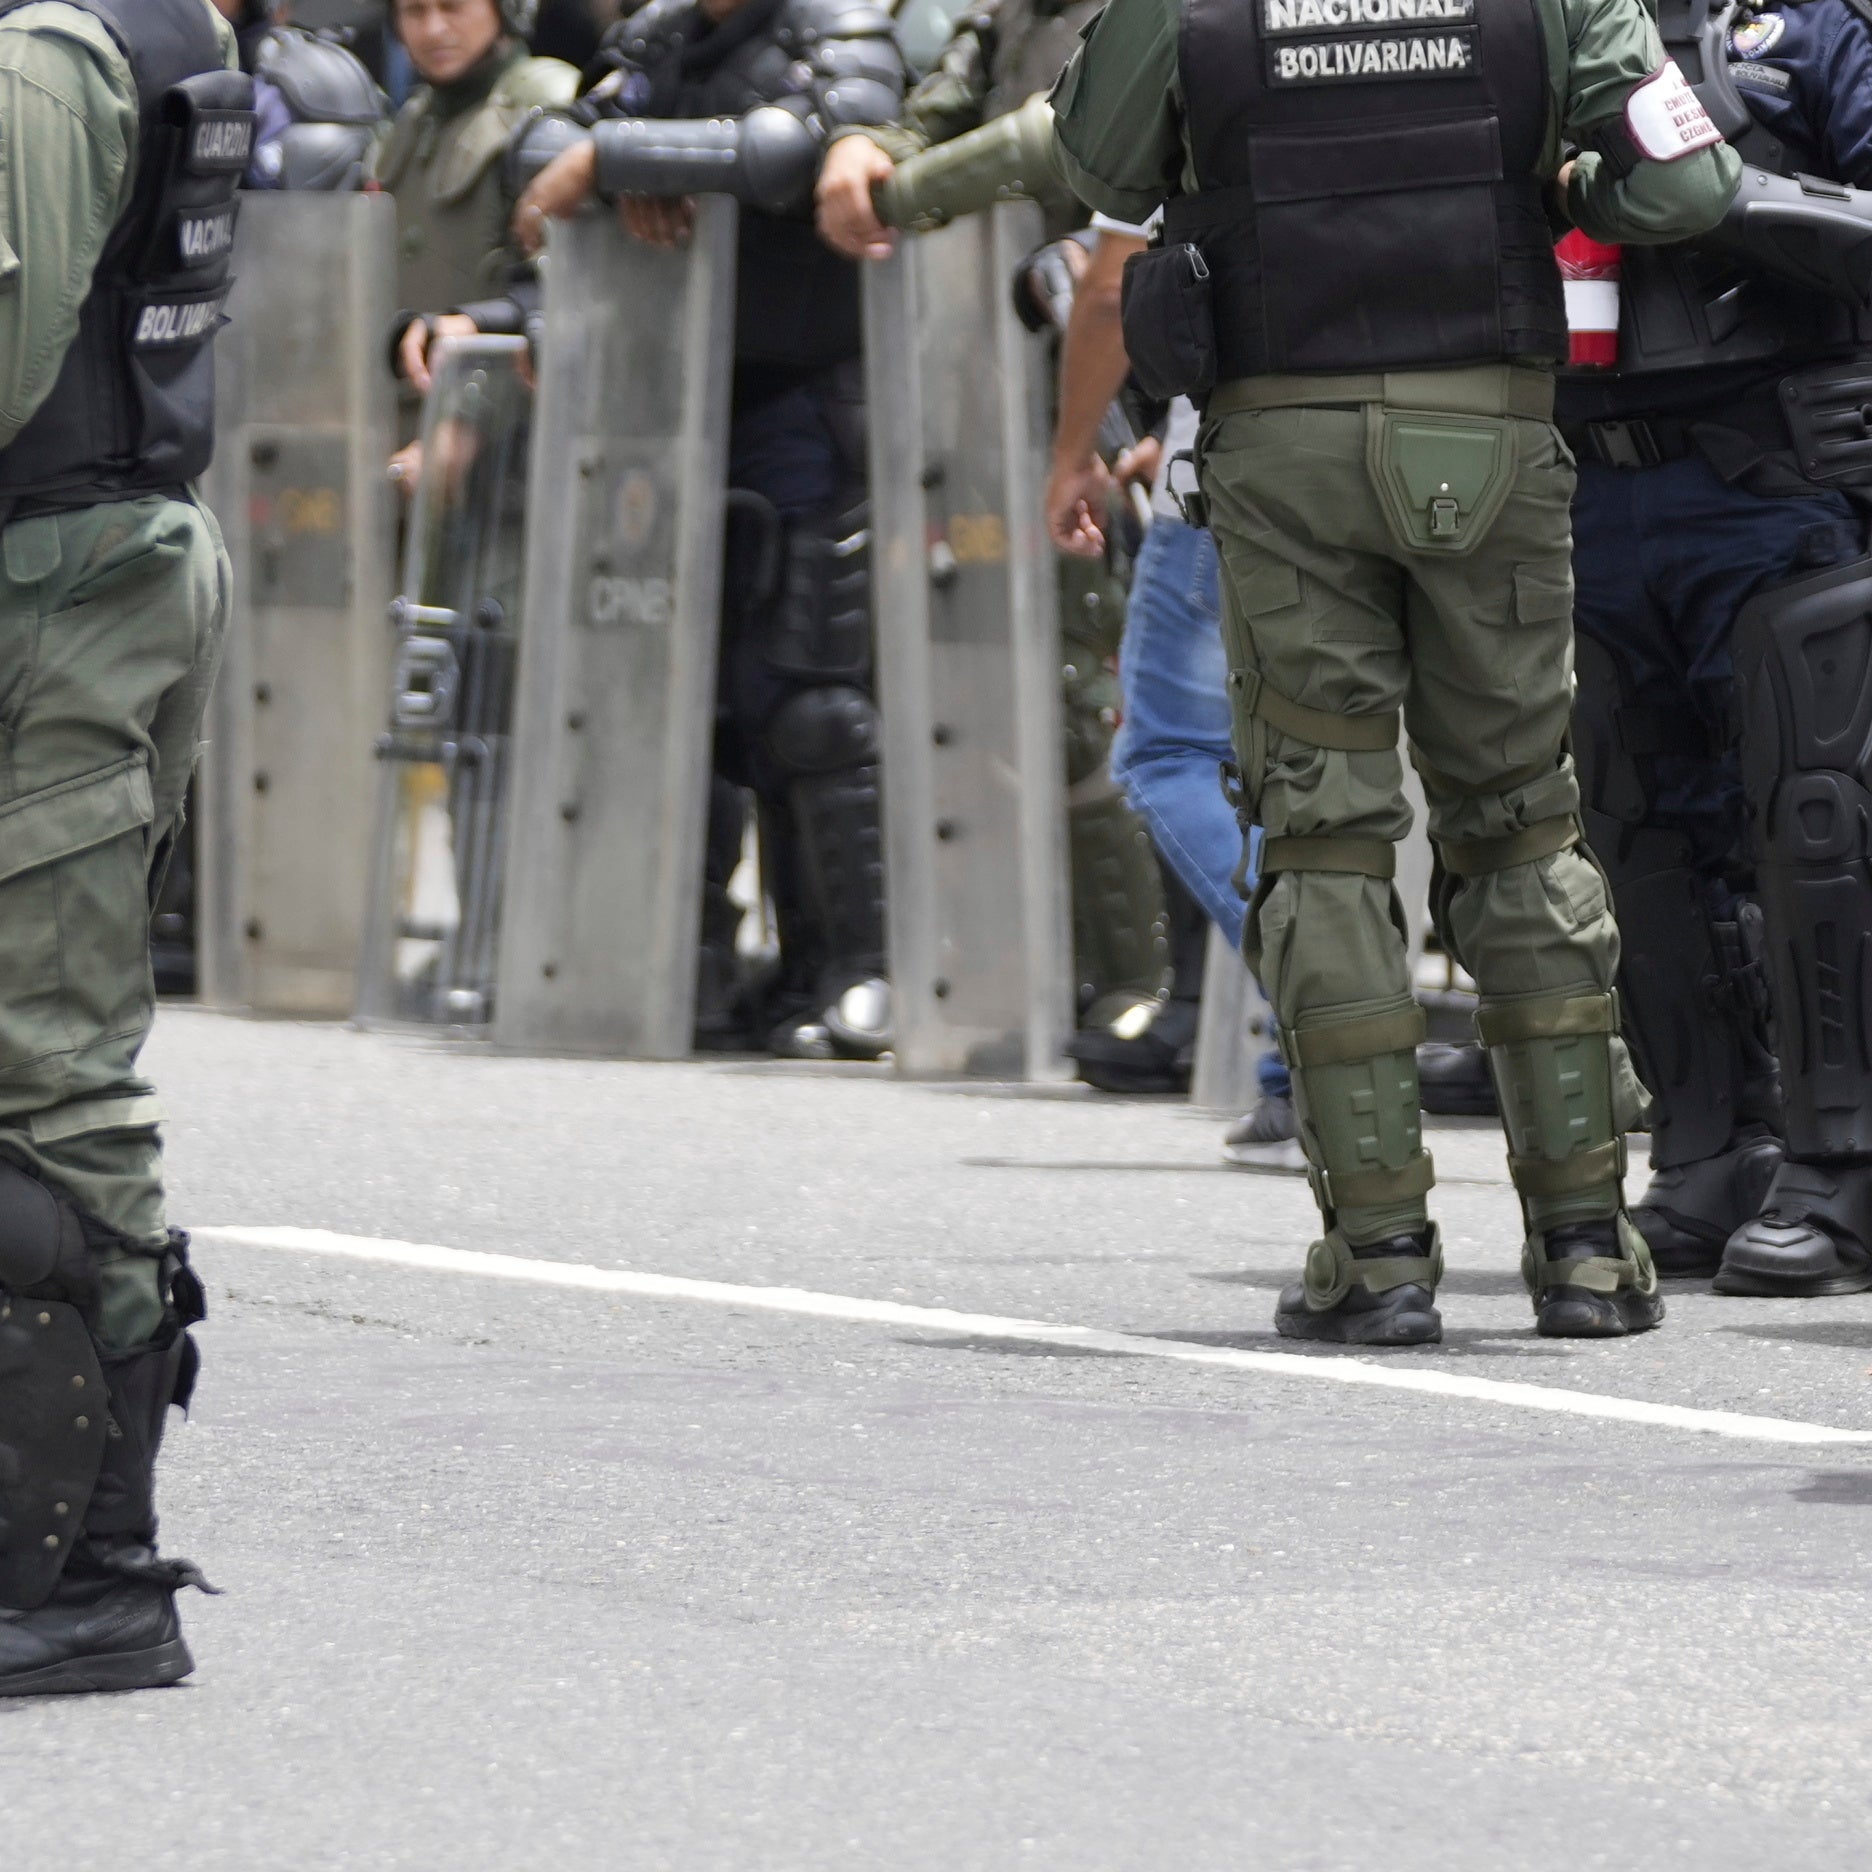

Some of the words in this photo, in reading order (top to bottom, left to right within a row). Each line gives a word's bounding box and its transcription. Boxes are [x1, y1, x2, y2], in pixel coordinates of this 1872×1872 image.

[1278, 37, 1466, 79] BOLIVARIANA
[1729, 63, 1765, 74] OLICIA
[195, 121, 252, 159] GUARDIA
